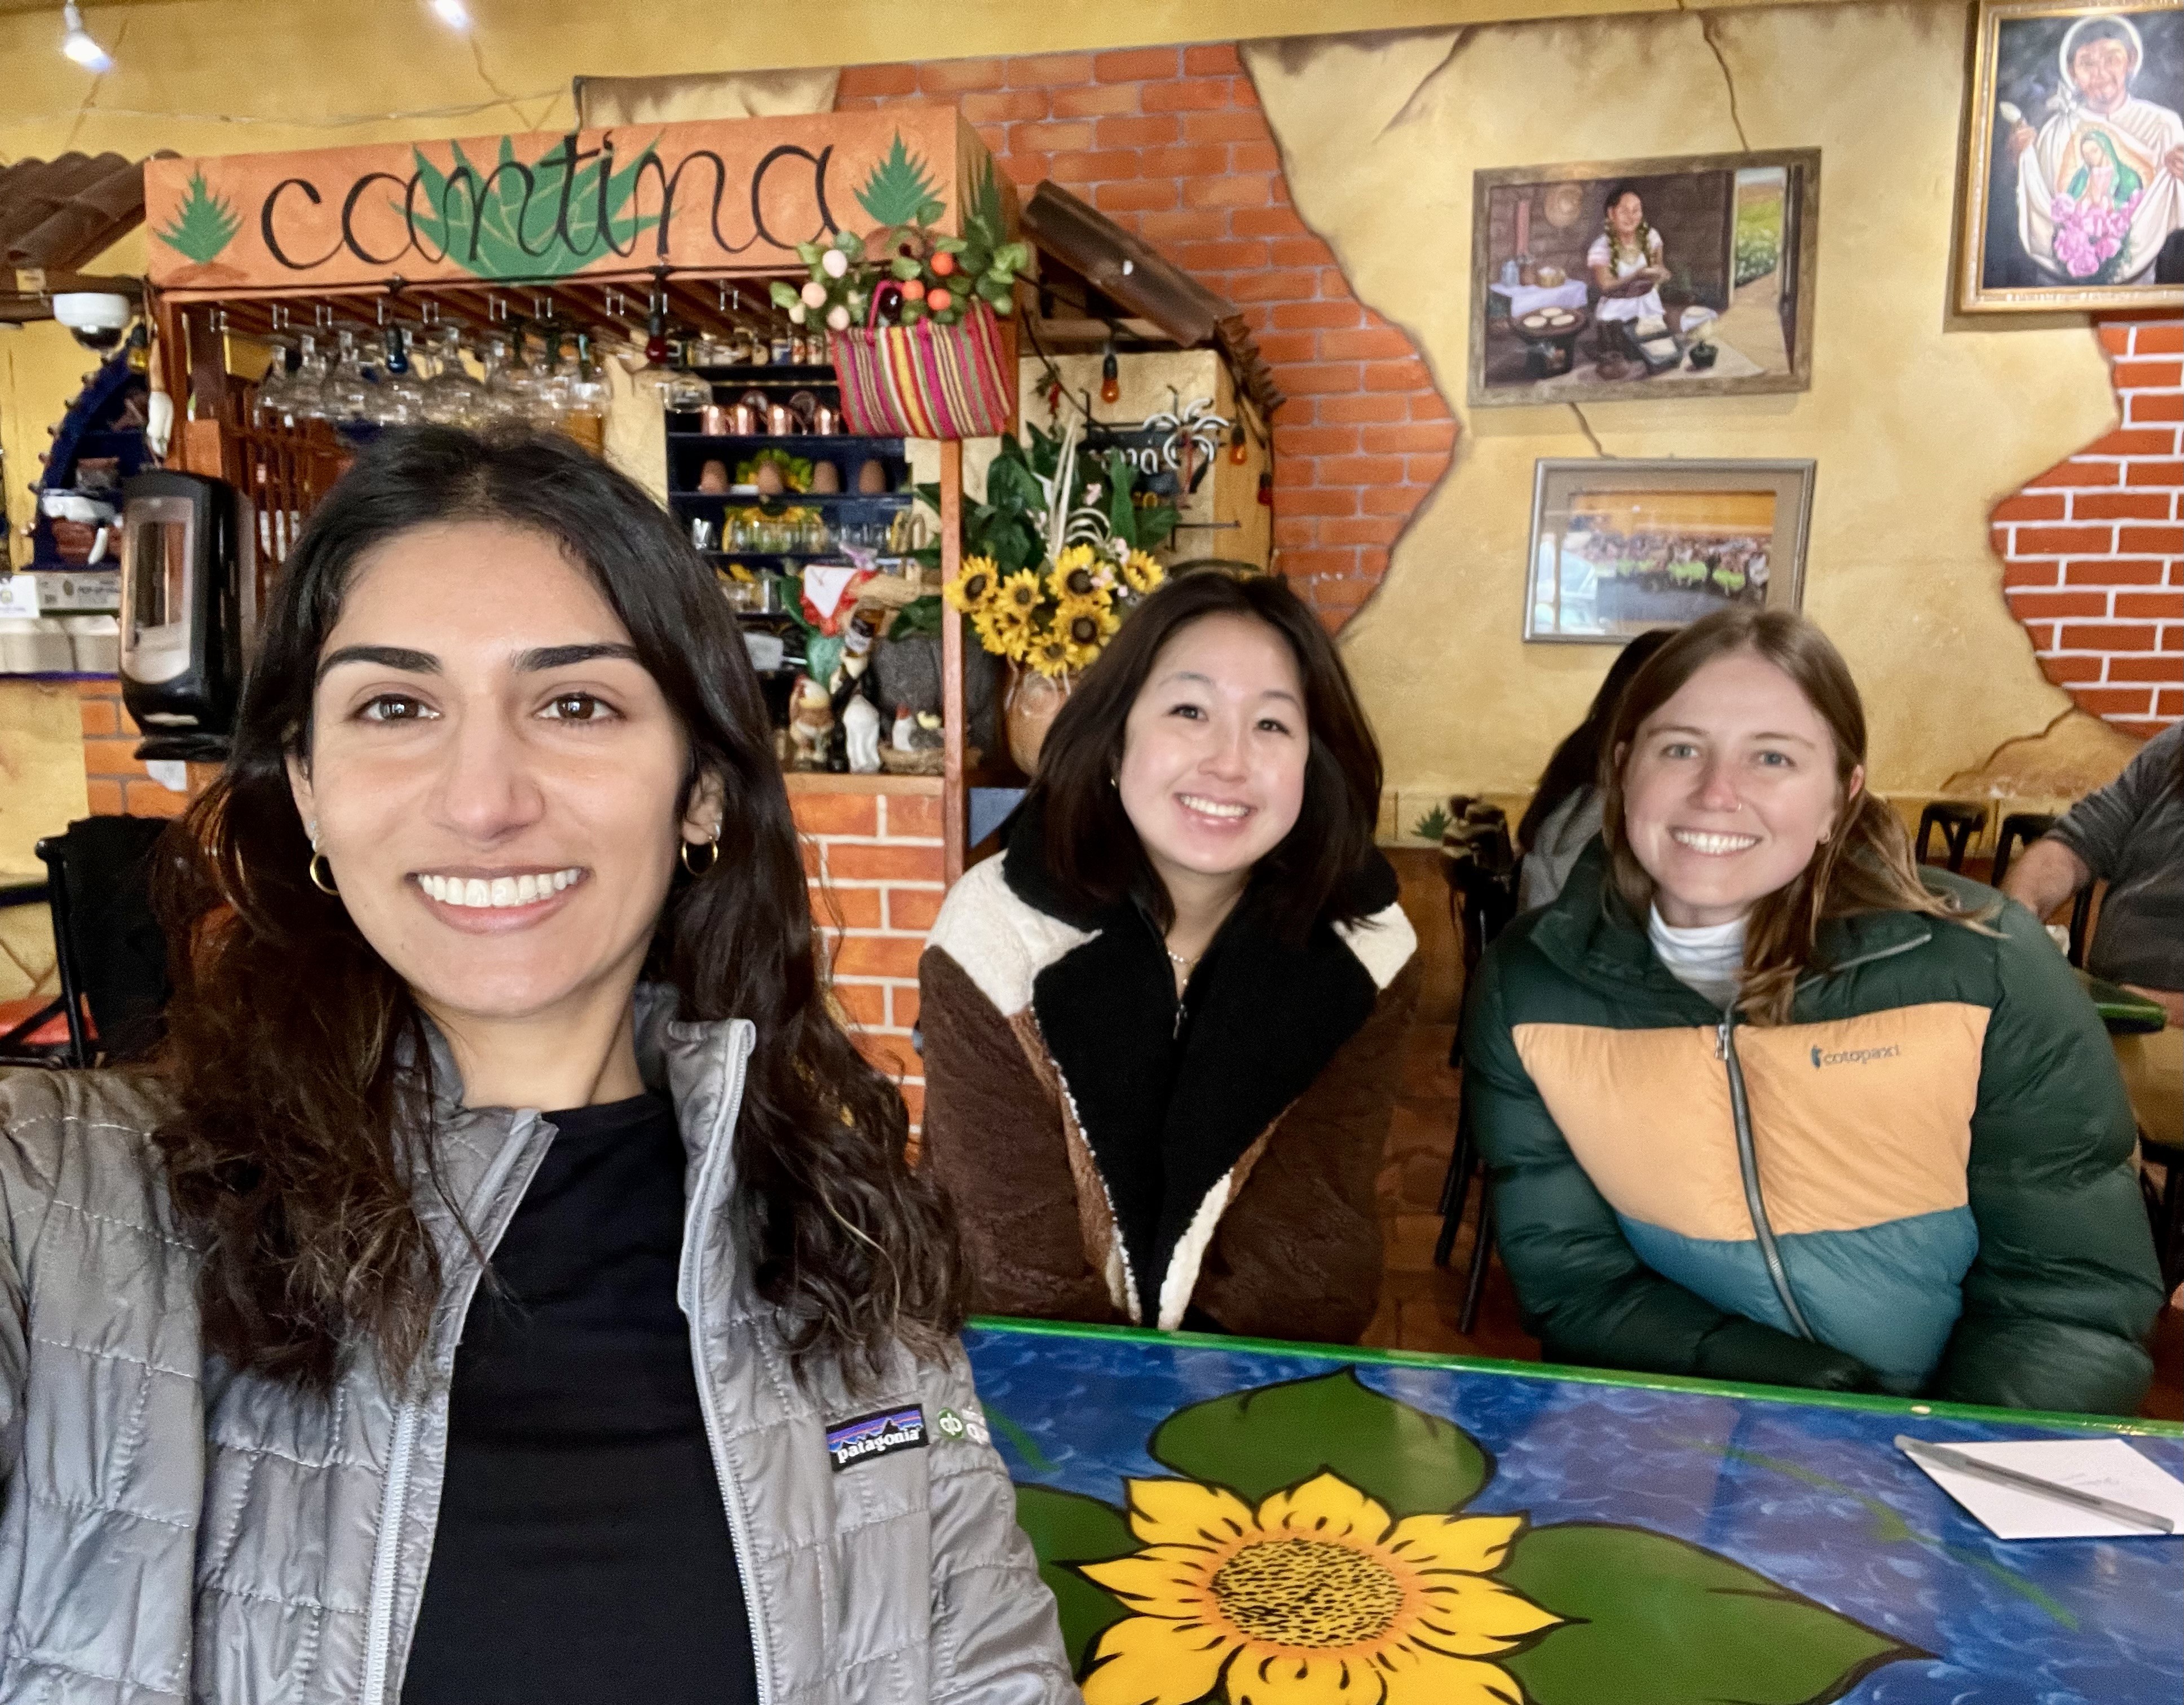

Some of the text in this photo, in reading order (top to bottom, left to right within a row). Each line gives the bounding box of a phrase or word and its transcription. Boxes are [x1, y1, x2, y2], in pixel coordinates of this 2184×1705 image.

[261, 130, 840, 270] cantina
[1824, 1045, 1899, 1064] cotopaxi
[837, 1429, 920, 1464] patagonia
